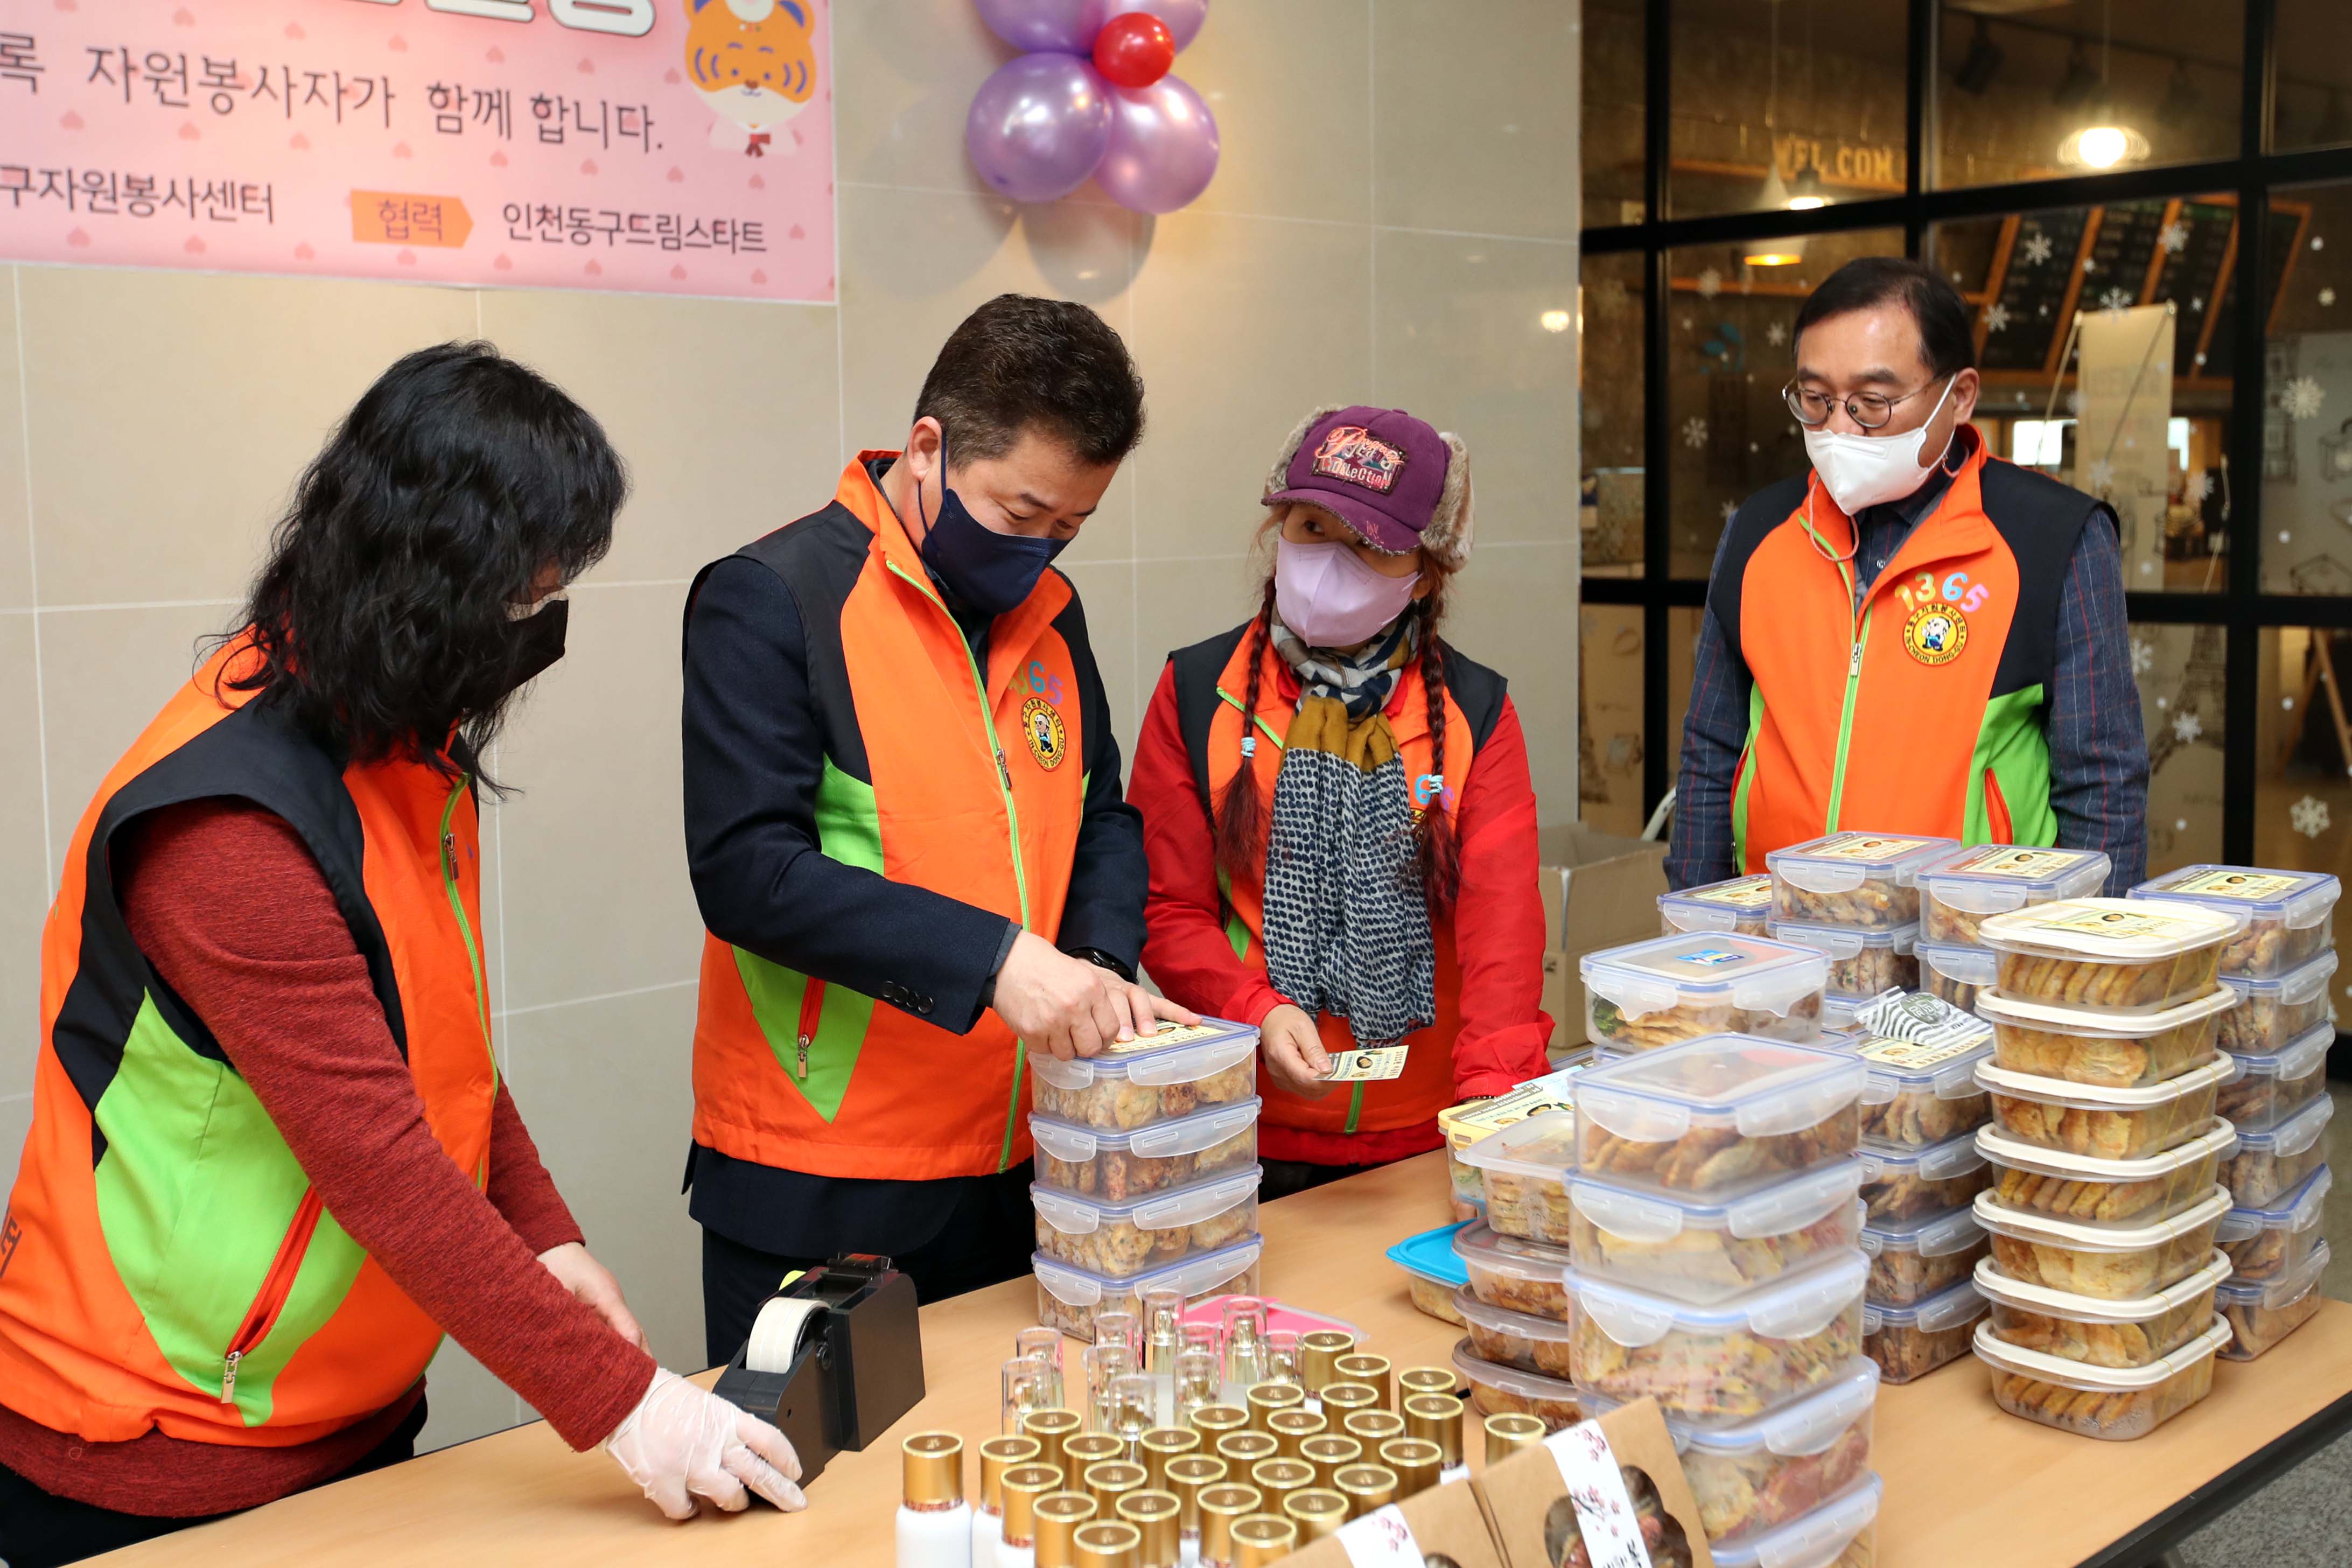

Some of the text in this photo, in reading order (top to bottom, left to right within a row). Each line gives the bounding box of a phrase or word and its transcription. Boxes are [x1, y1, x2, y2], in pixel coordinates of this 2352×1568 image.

[85, 46, 396, 129] 자원봉사자가
[426, 80, 511, 140] 함께
[530, 92, 662, 153] 합니다.
[0, 165, 275, 224] 구자원봉사센터
[378, 199, 443, 241] 협력
[503, 202, 767, 254] 인천동구드림스타트
[1894, 571, 1991, 612] 1365
